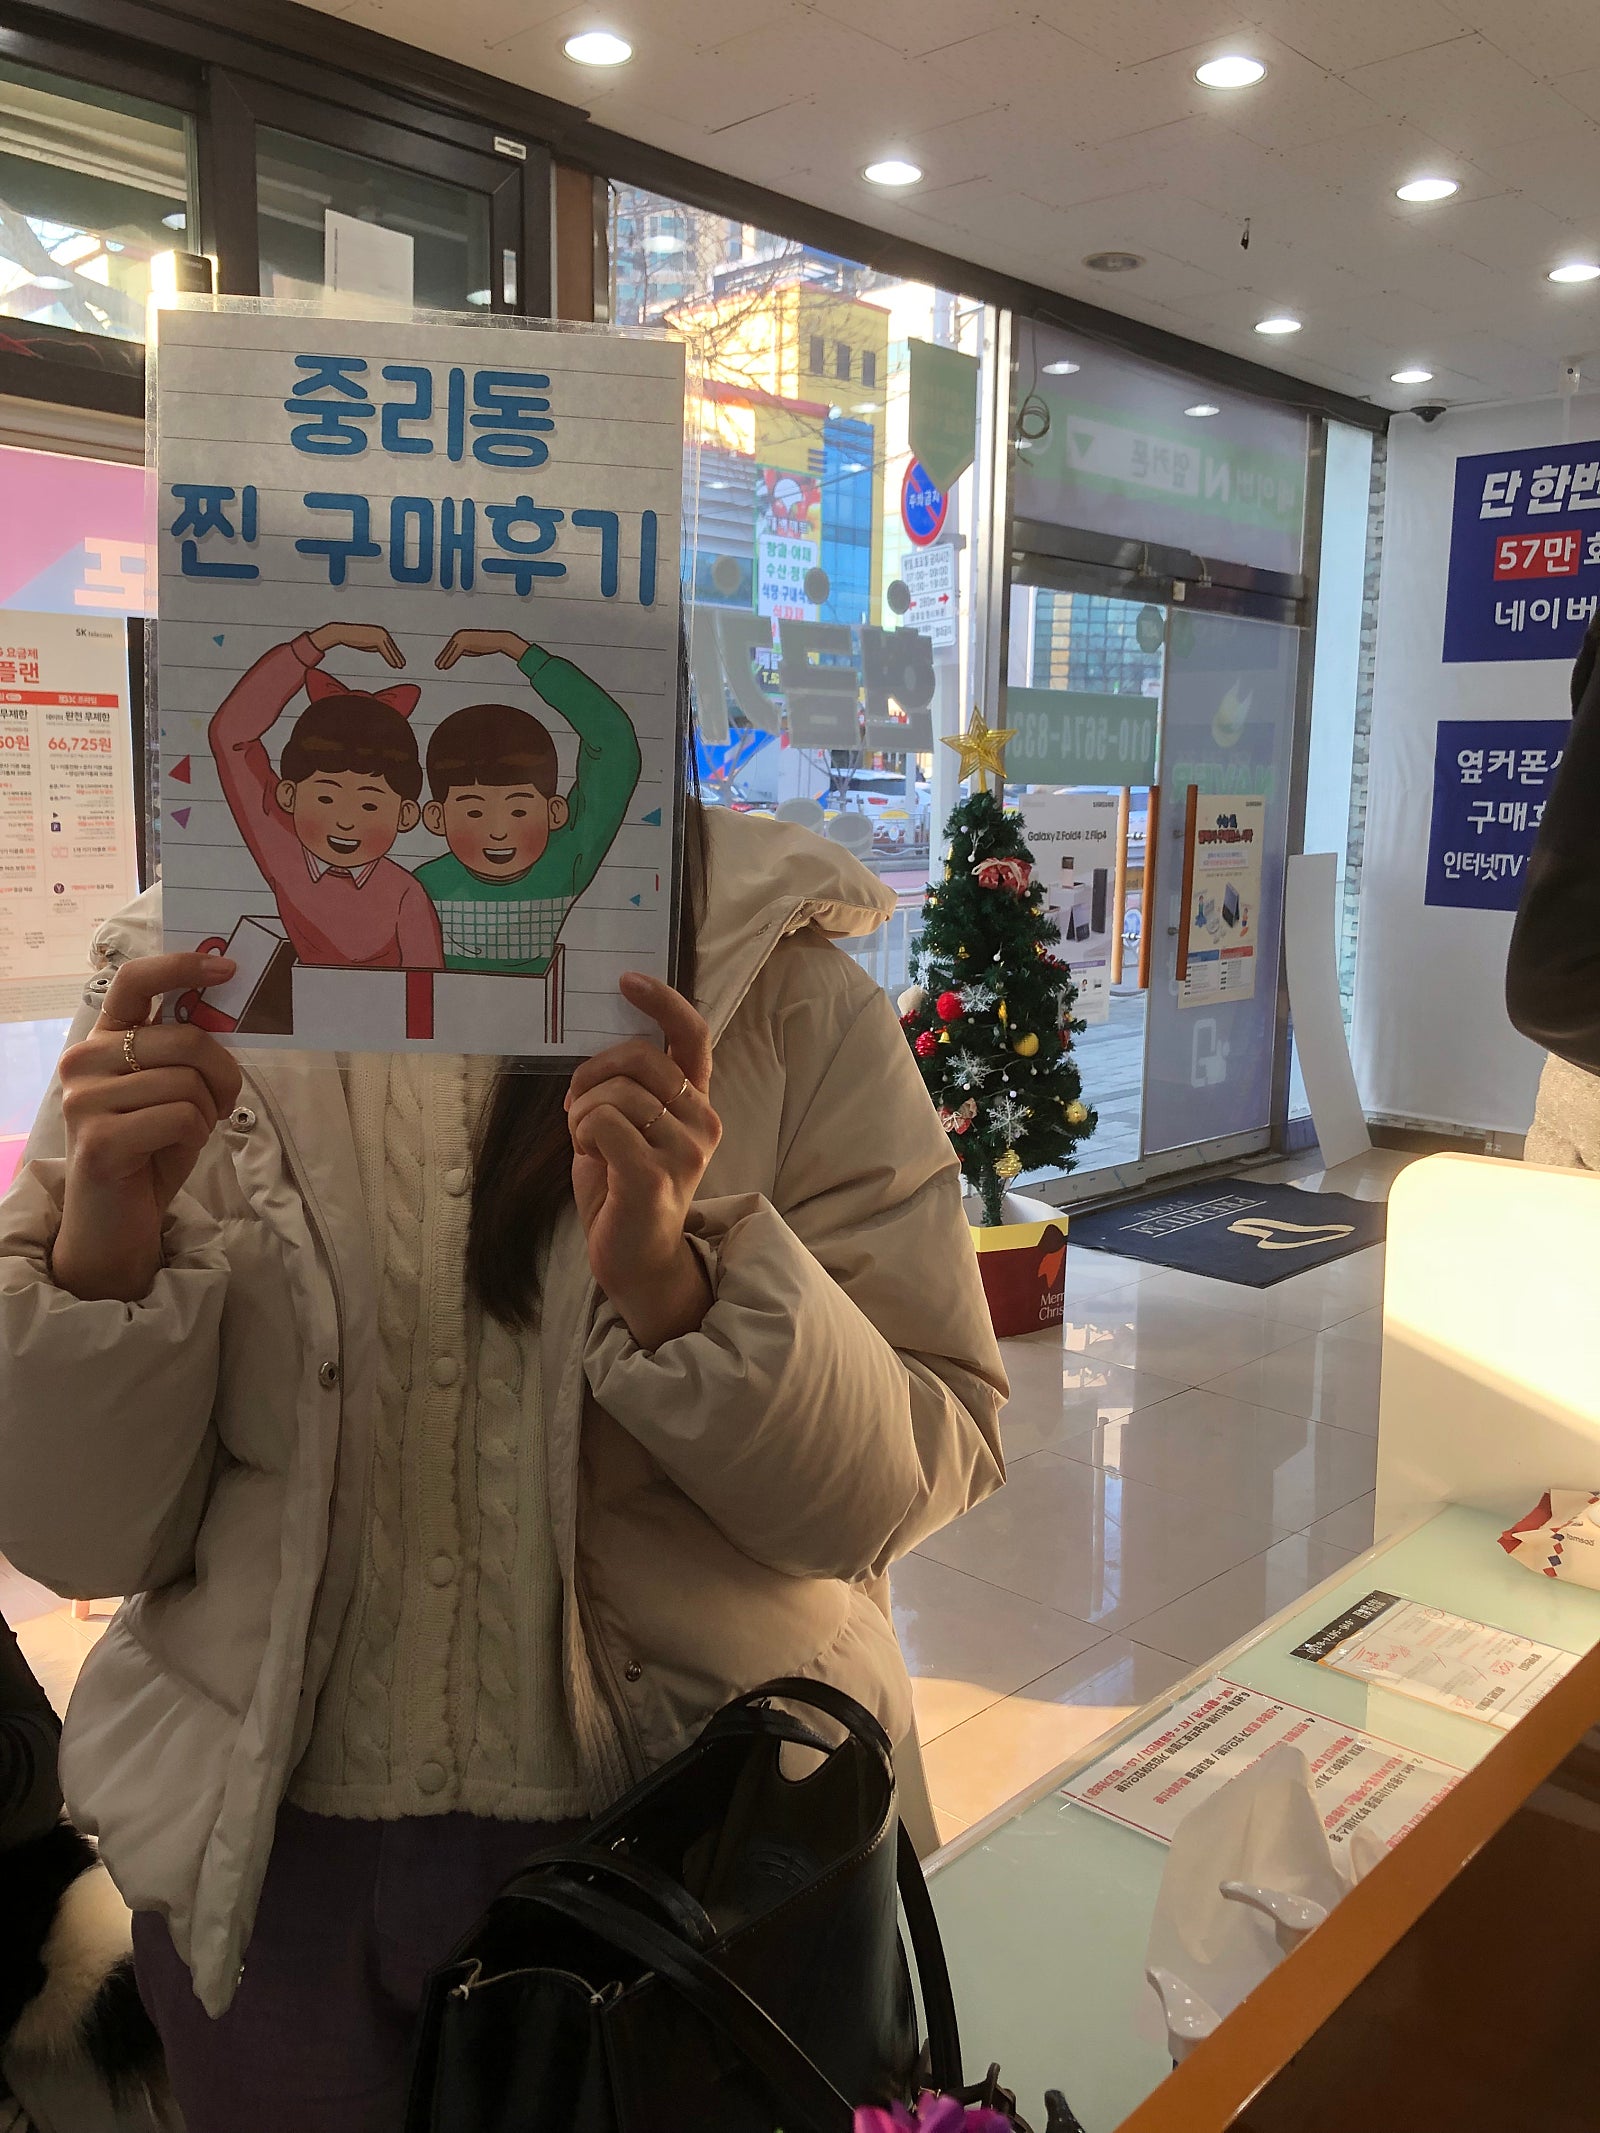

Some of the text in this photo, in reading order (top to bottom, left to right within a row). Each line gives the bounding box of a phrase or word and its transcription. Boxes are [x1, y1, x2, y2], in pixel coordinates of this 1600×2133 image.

[283, 355, 555, 468] 중리동
[909, 490, 942, 509] 주차금지
[1480, 470, 1522, 519] 단
[171, 484, 260, 580] 찐
[295, 492, 658, 607] 구매후기
[1498, 536, 1577, 573] 57만
[1495, 595, 1598, 632] 네이버
[76, 628, 87, 637] SK
[6, 647, 39, 660] 요금제
[65, 711, 83, 721] 완전
[85, 712, 110, 722] 무제한
[48, 737, 111, 753] 66,725원
[1028, 830, 1107, 843] Galaxy Z Fold4 Z Flip4
[1443, 851, 1524, 882] 인터넷TV
[1132, 1197, 1257, 1235] PREMIUM
[1134, 1200, 1194, 1218] STORE
